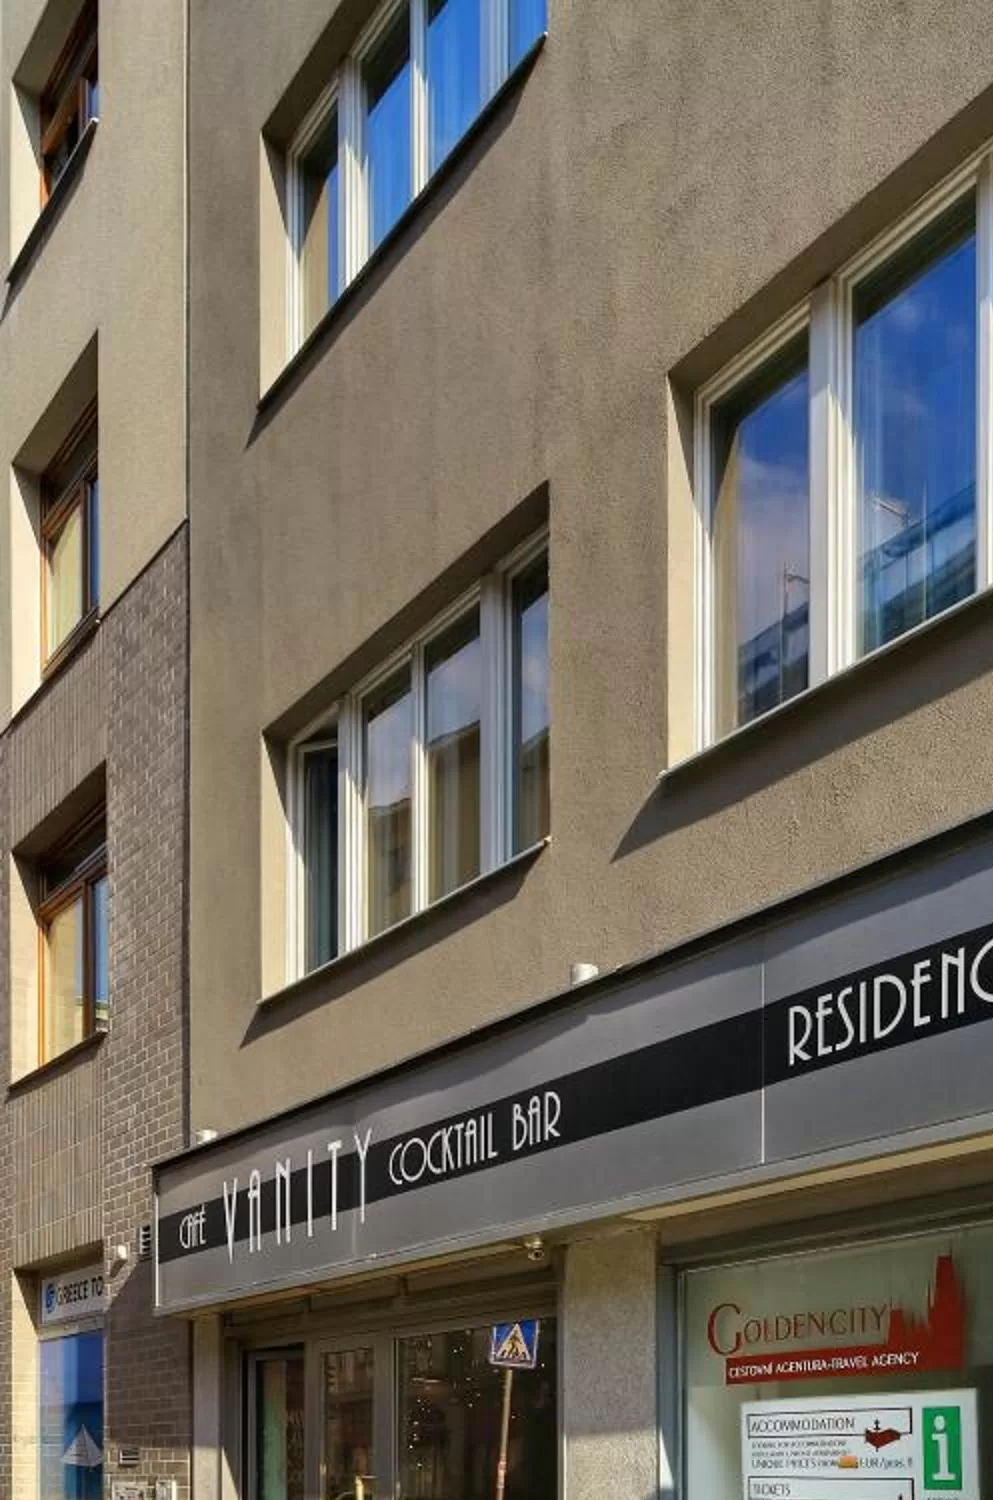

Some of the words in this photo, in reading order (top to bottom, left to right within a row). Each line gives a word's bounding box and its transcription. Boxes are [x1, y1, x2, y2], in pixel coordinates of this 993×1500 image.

[179, 1204, 207, 1250] CAFÉ
[223, 1128, 372, 1264] VANITY
[389, 1112, 498, 1185] COCKTAIL
[512, 1091, 561, 1151] BAR
[871, 1352, 919, 1367] AGENCY
[751, 1417, 855, 1433] ACCOMMODATION
